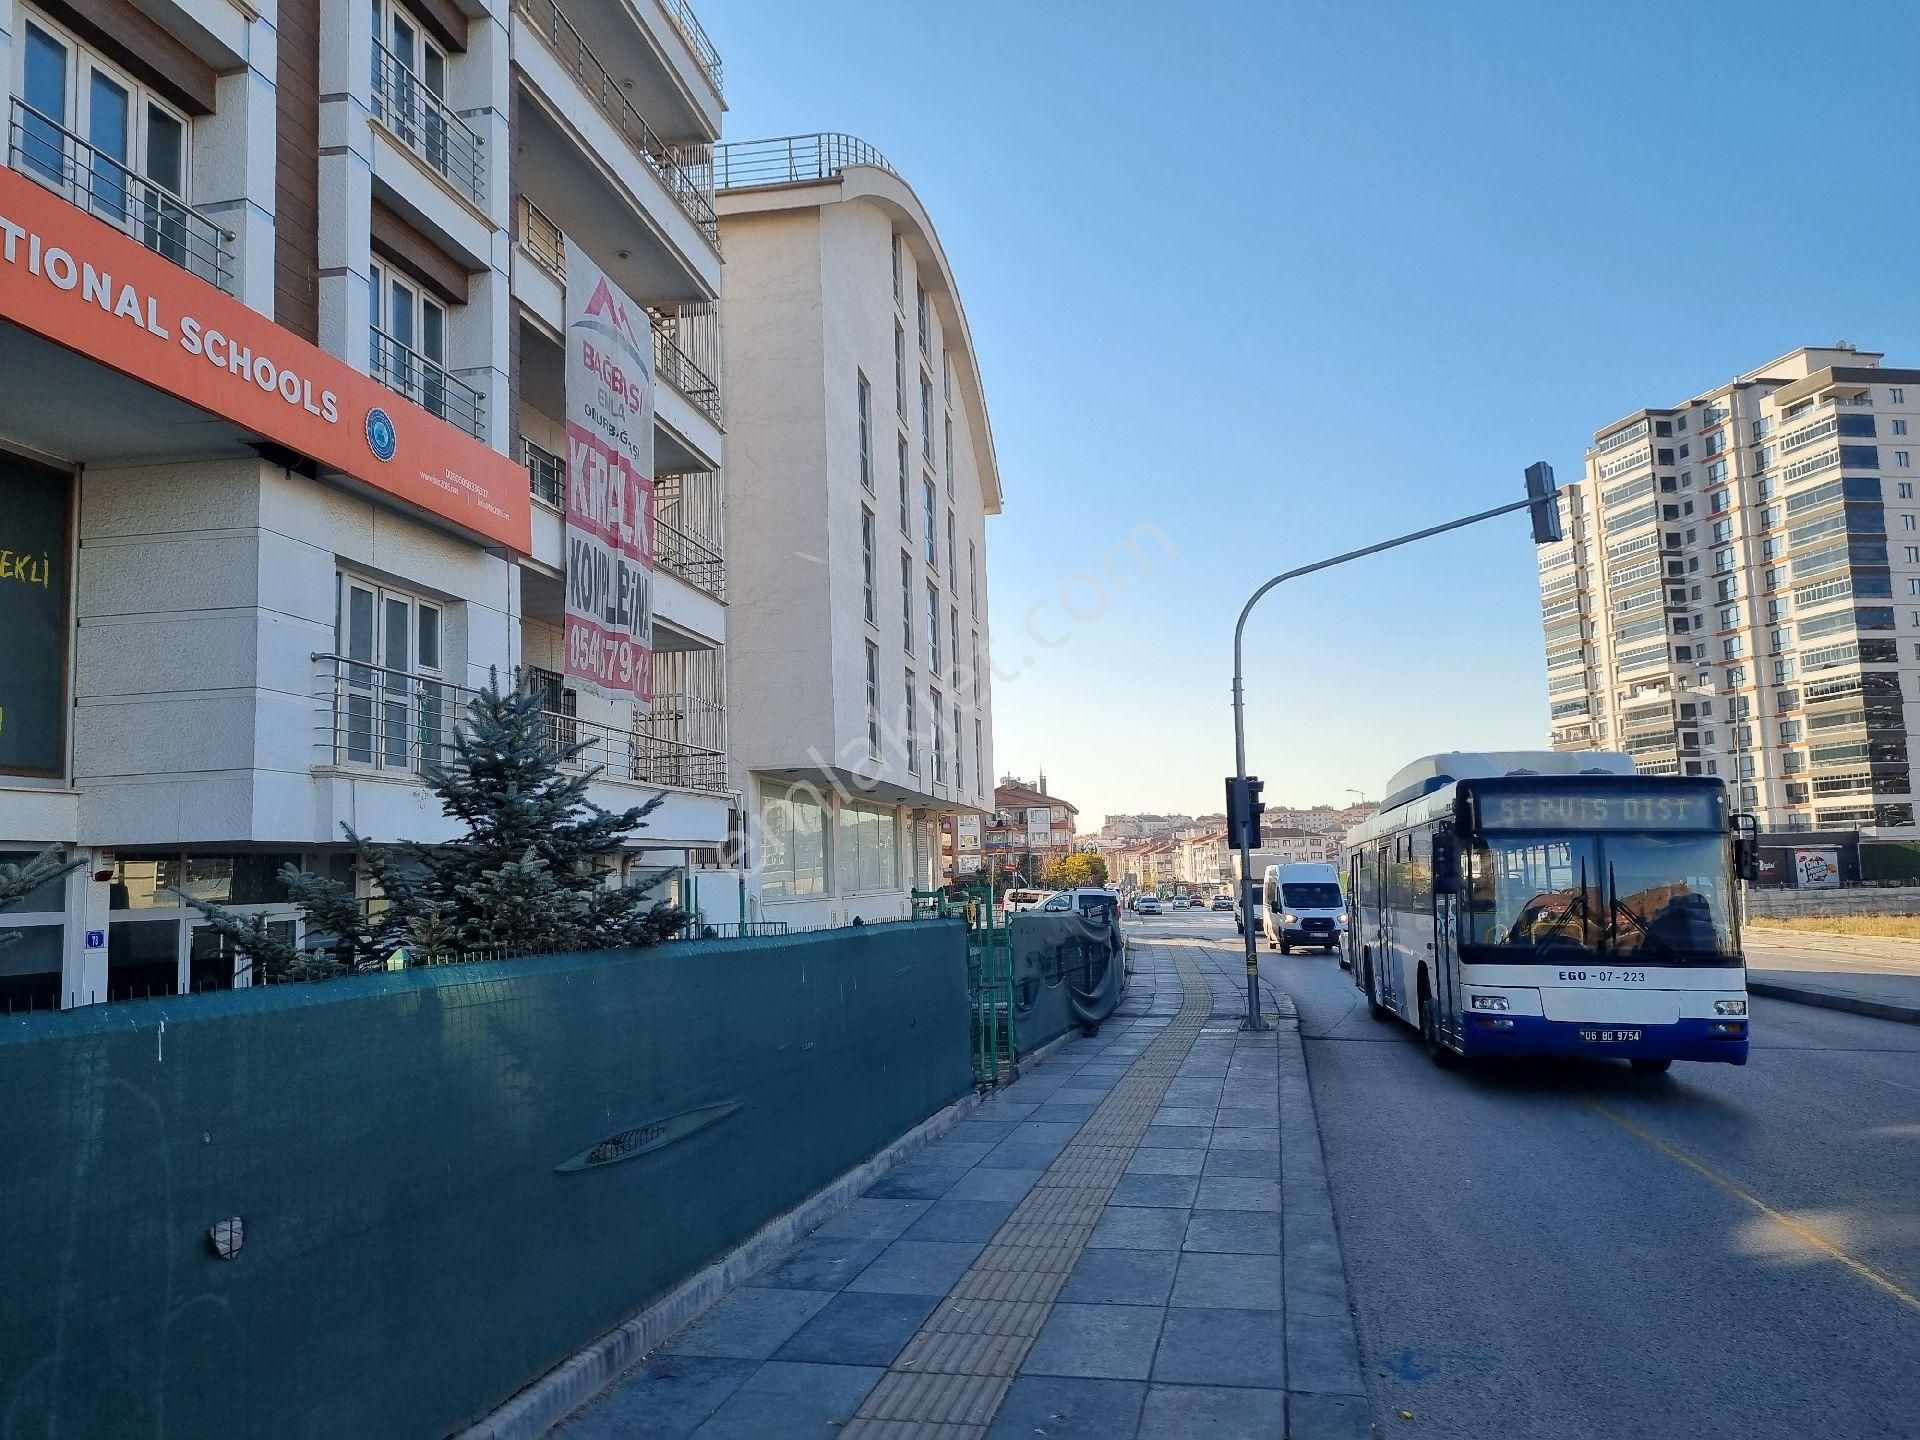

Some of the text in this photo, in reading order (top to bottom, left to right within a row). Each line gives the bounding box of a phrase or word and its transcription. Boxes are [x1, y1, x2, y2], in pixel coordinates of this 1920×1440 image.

[180, 316, 338, 424] SCHOOLS
[569, 436, 649, 555] KİRALK
[1585, 1031, 1597, 1040] 06
[1617, 1031, 1640, 1041] 9754
